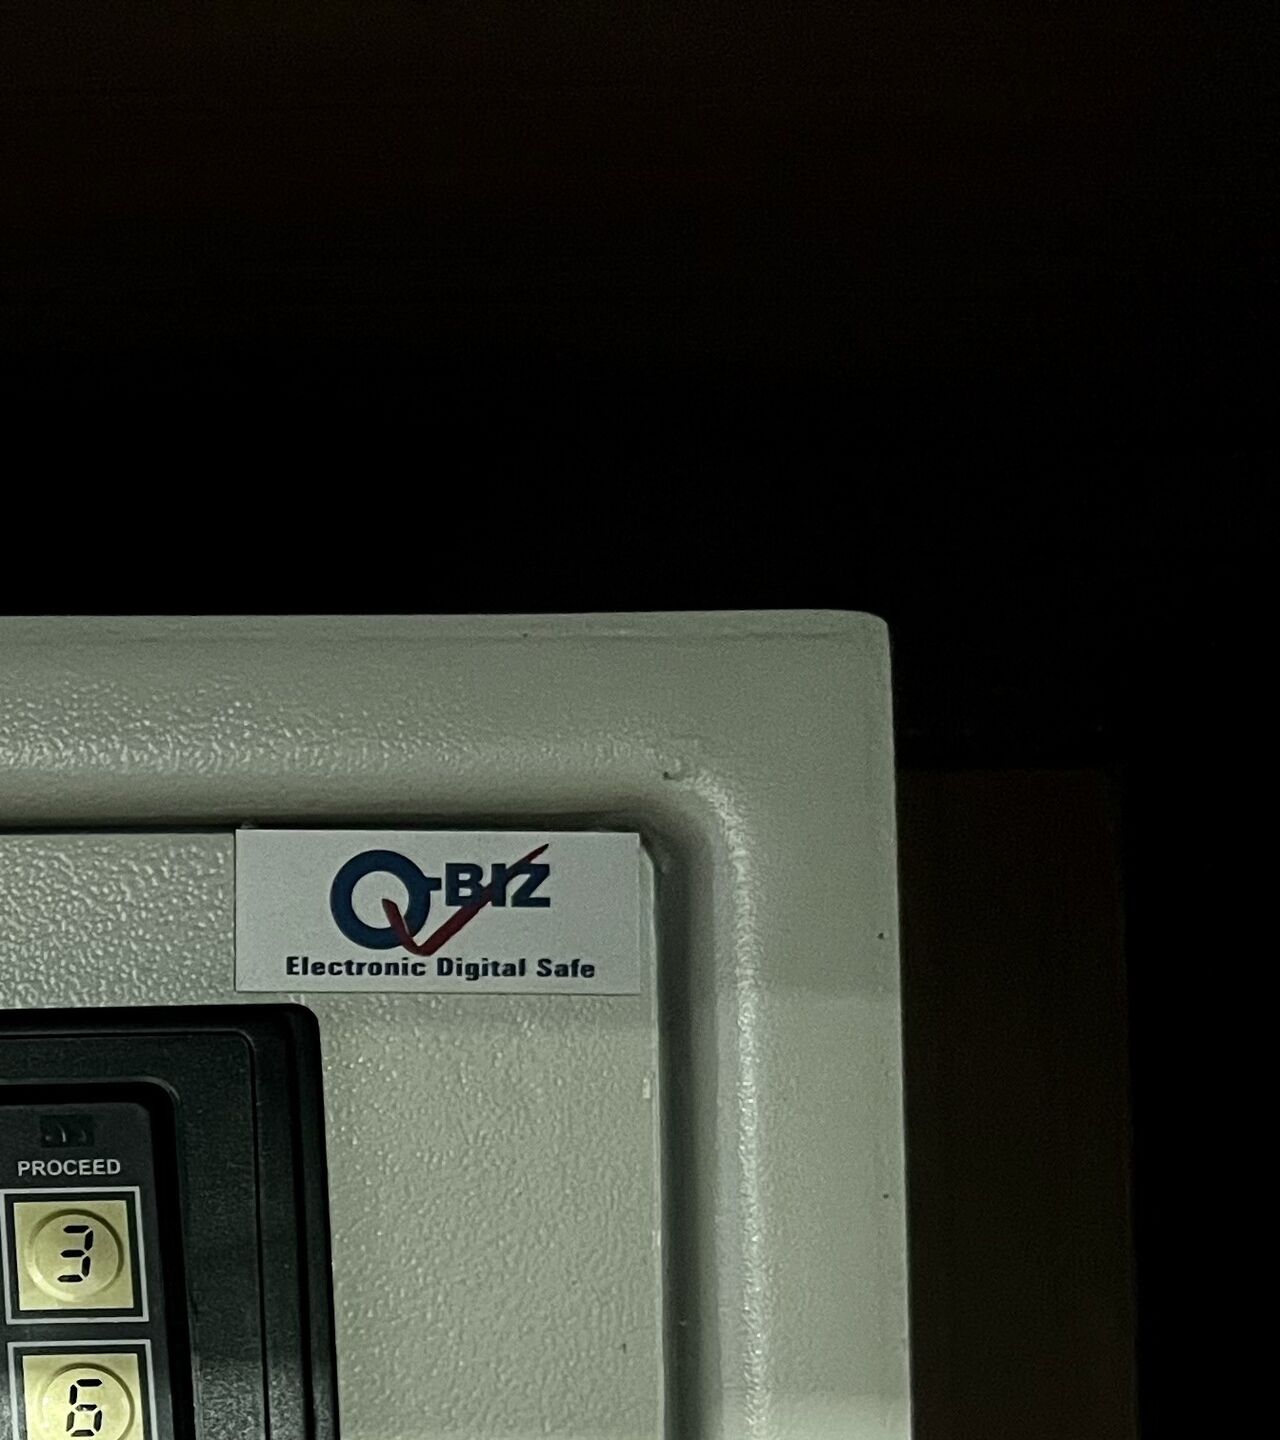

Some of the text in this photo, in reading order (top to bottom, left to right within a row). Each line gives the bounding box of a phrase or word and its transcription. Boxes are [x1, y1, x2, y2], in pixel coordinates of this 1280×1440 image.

[286, 956, 596, 981] Electronic Digital Safe
[17, 1158, 122, 1177] PROCEED
[56, 1224, 94, 1283] 3
[65, 1378, 103, 1438] 6
